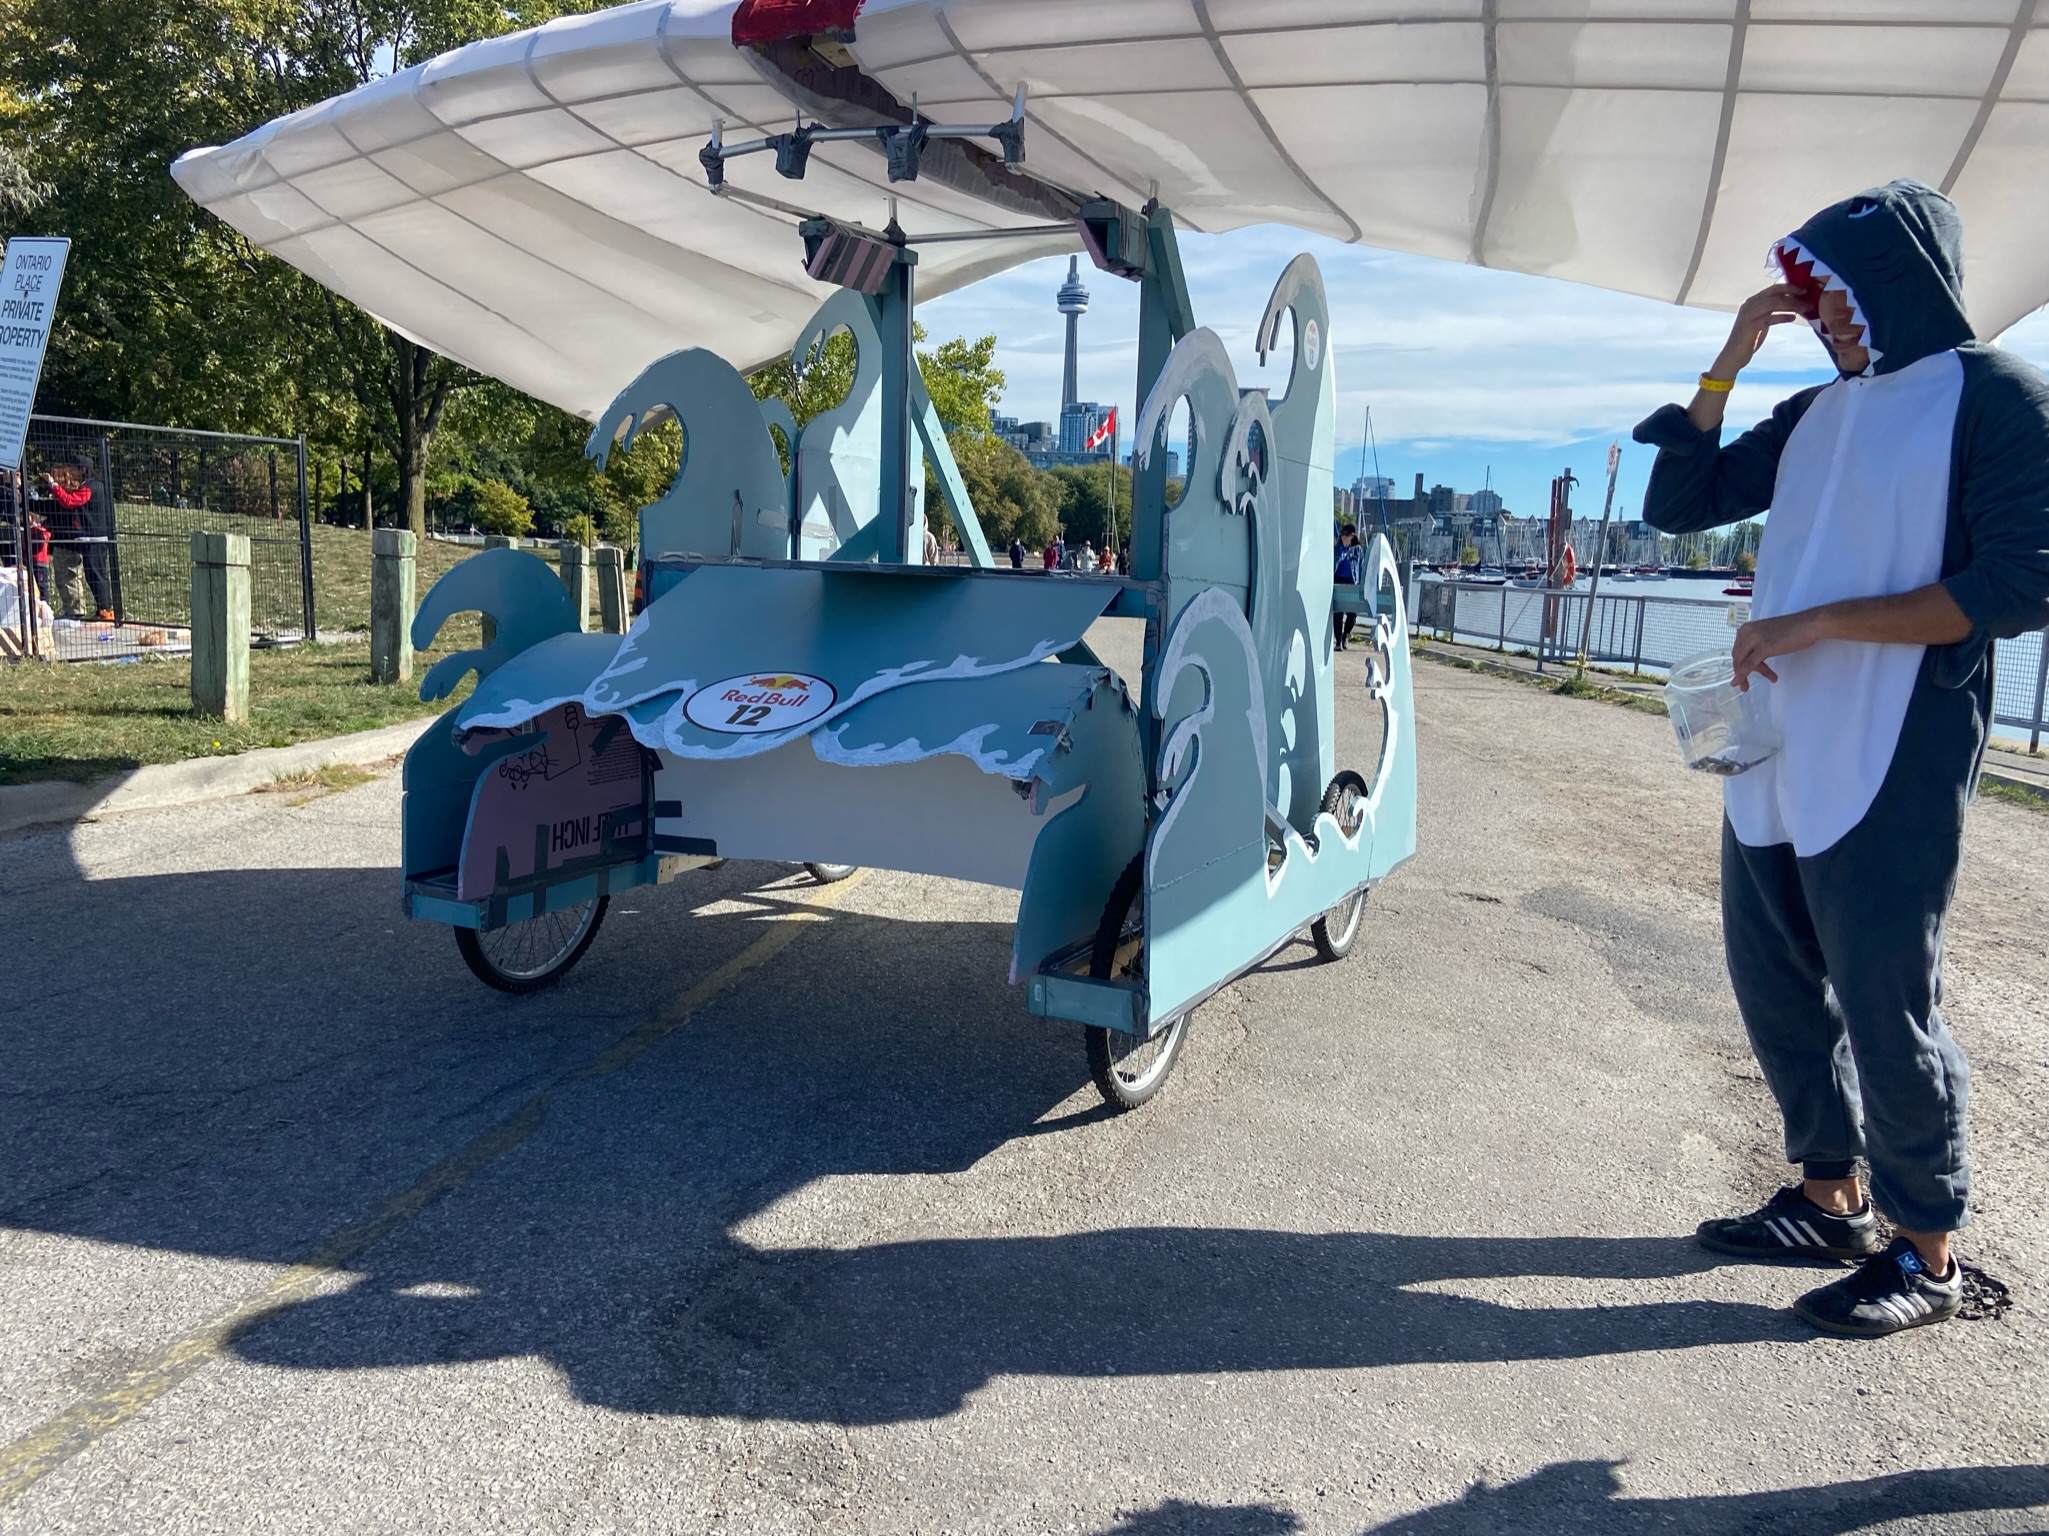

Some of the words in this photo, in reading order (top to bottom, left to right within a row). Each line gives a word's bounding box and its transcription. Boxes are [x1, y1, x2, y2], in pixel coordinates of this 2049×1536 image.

[15, 254, 52, 271] ONTARIO
[15, 274, 43, 290] PLACE
[1, 300, 44, 322] PRIVATE
[720, 689, 768, 703] Red
[764, 692, 810, 707] Bull
[725, 704, 772, 727] 12
[552, 816, 590, 852] INCH
